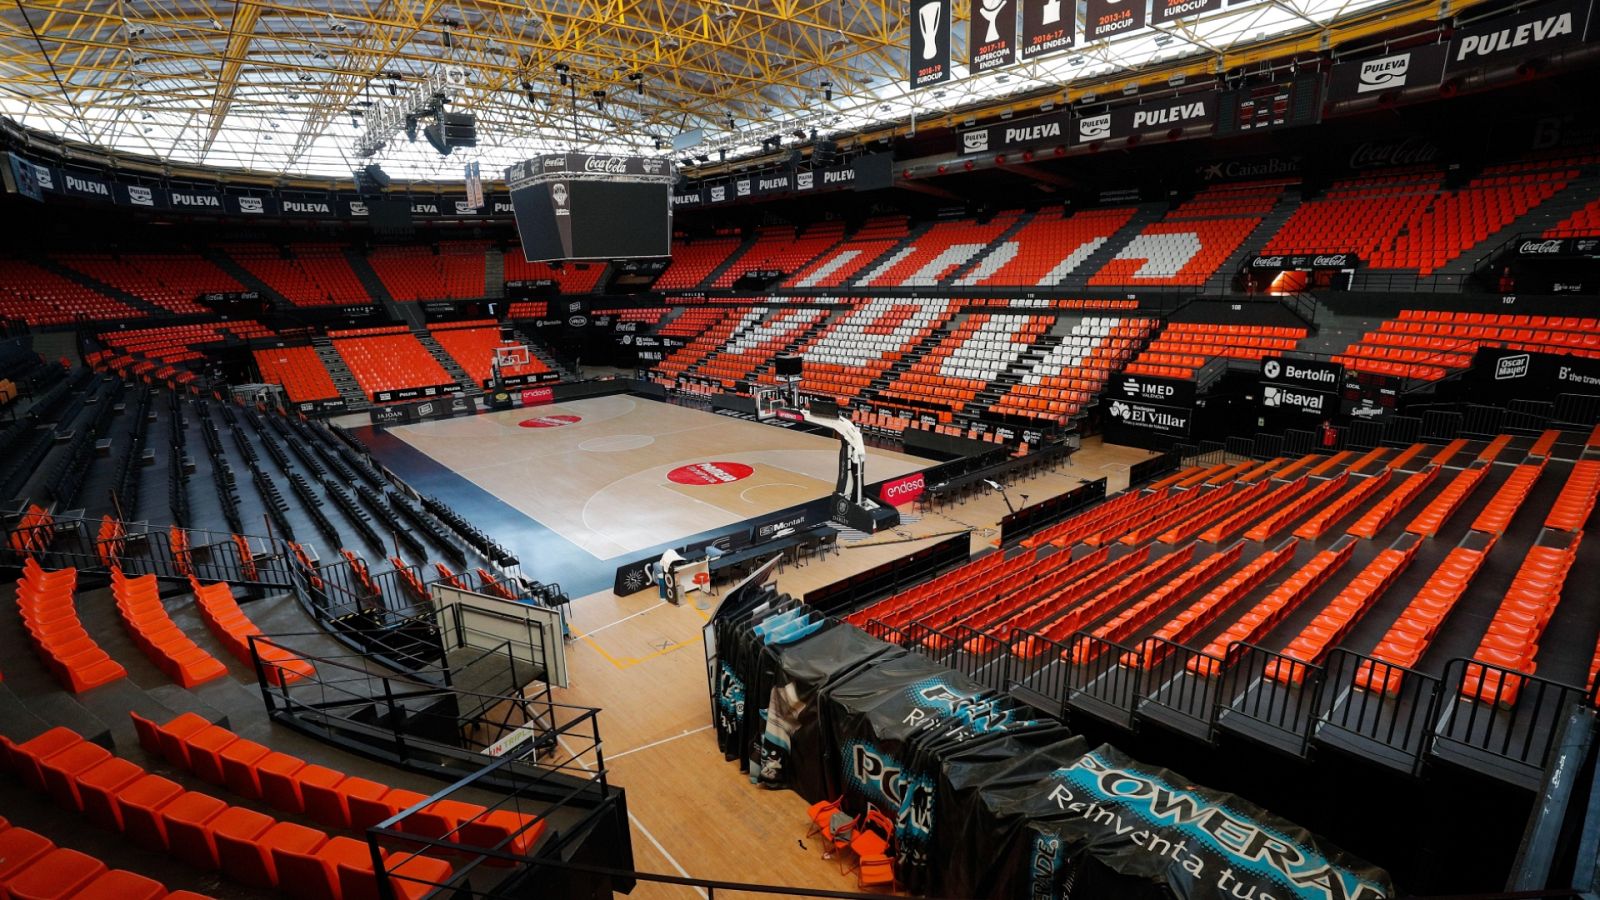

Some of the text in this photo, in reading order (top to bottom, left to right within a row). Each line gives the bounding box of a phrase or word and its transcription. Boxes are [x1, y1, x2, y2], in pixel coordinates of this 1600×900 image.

[1164, 0, 1207, 16] EUROCUP
[1099, 10, 1132, 25] 2013-14
[1095, 18, 1134, 34] EUROCUP
[1033, 30, 1063, 44] 2016-17
[1457, 12, 1572, 61] PULEVA
[979, 41, 1006, 54] 2017-18
[1025, 36, 1072, 54] LIGA ENDESA
[974, 48, 1010, 63] SUPERCOPA
[918, 65, 942, 76] 2018-19
[980, 58, 1004, 70] ENDESA
[1364, 60, 1406, 74] PULEVA
[917, 73, 943, 84] EUROCUP
[1134, 102, 1205, 128] PULEVA
[1081, 118, 1109, 128] PULEVA
[965, 133, 987, 141] PULEVA
[1005, 123, 1061, 143] PULEVA
[584, 155, 628, 173] Coca-Cola
[66, 176, 109, 195] PULEVA
[759, 177, 788, 190] PULEVA
[129, 187, 151, 196] PULEVA
[172, 193, 219, 206] PULEVA
[283, 201, 330, 213] PULEVA
[411, 204, 438, 213] LEVA
[494, 202, 515, 211] PUL
[1502, 296, 1516, 304] 107
[1502, 359, 1526, 367] Oscar
[1285, 365, 1335, 383] Bertolín
[1498, 366, 1525, 377] Mayer
[1569, 374, 1582, 382] the
[1583, 374, 1600, 385] trav
[523, 389, 552, 398] endesa
[1142, 384, 1174, 396] IMED
[1281, 389, 1324, 409] isaval
[1132, 410, 1186, 428] El Villar
[887, 479, 924, 498] endesa
[1047, 783, 1203, 880] Reinventa
